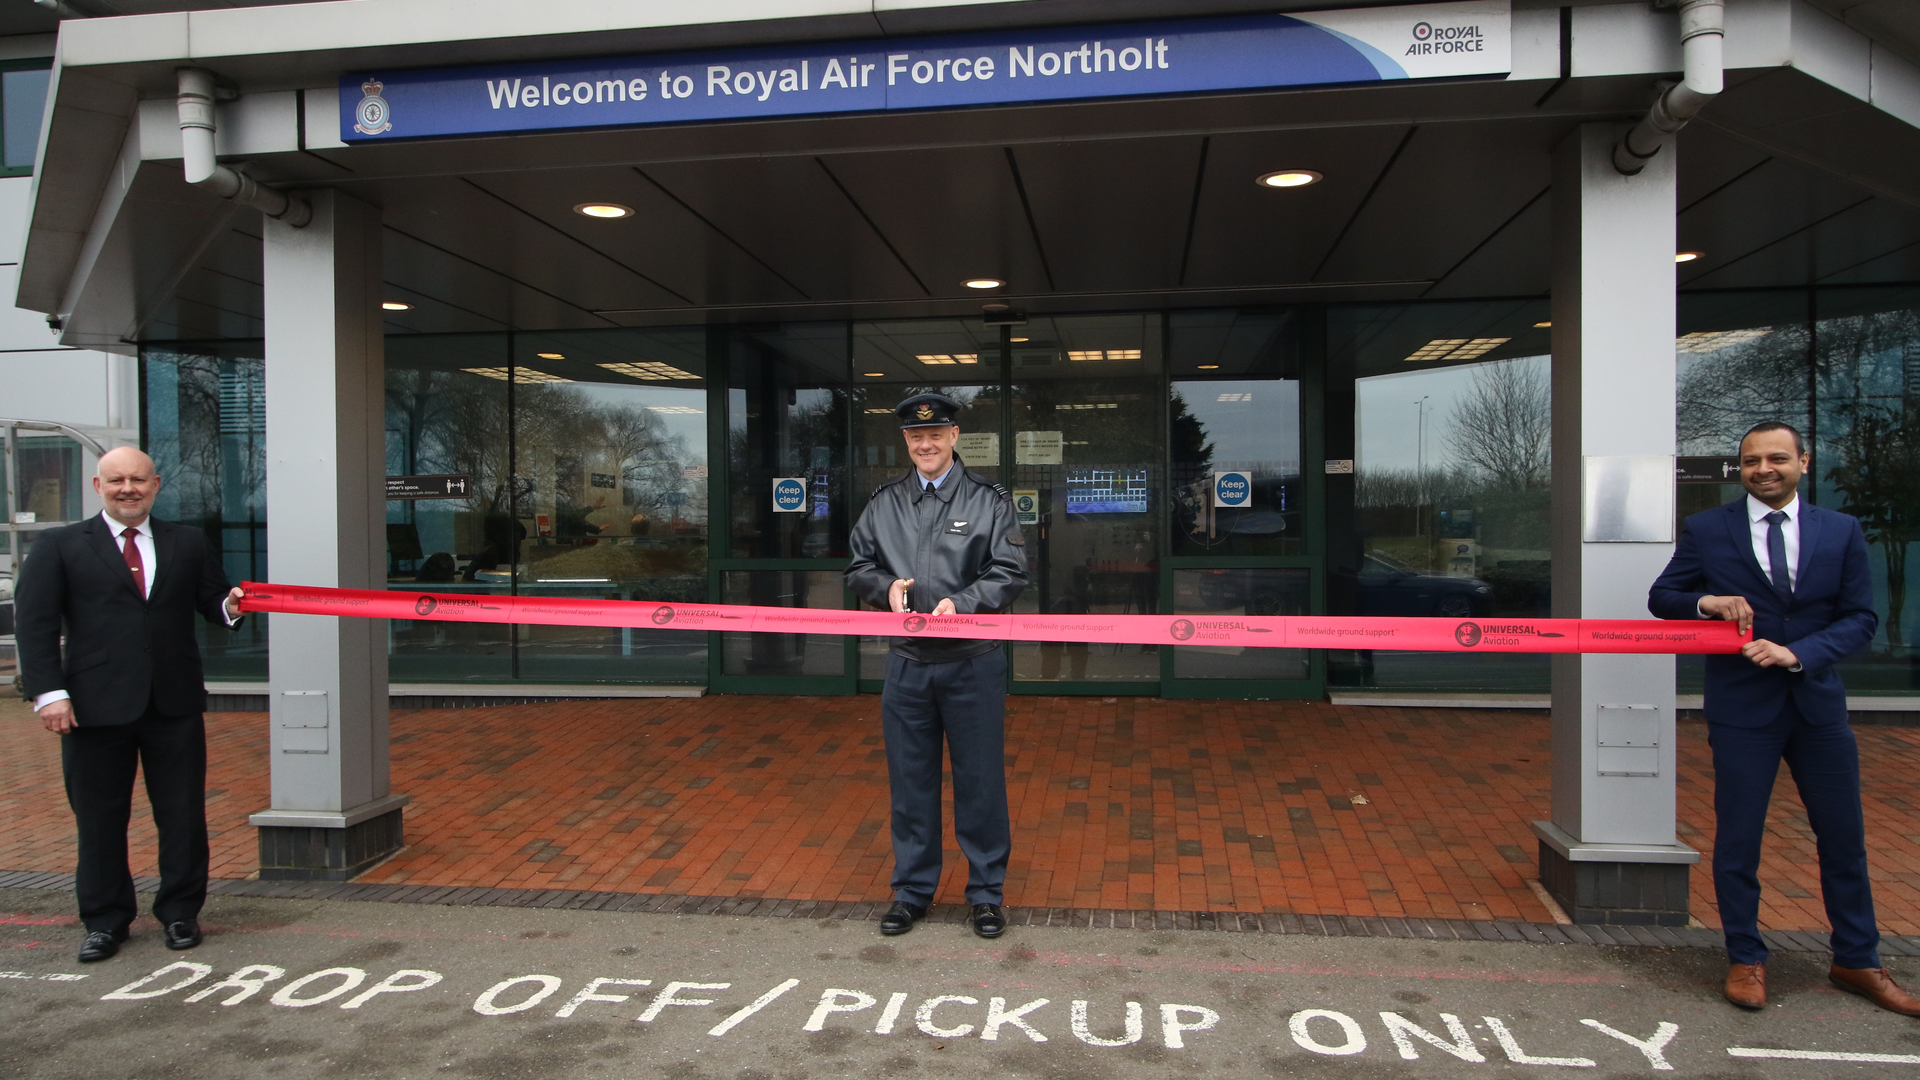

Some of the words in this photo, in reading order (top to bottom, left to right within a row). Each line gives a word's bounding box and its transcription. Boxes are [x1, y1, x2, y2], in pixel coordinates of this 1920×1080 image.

[1434, 25, 1484, 40] ROYAL
[1405, 43, 1432, 56] AIR
[1434, 39, 1484, 54] FORCE
[486, 76, 648, 110] Welcome
[658, 70, 695, 99] to
[706, 60, 808, 102] Royal
[819, 57, 876, 90] Air
[887, 54, 996, 87] Force
[1008, 38, 1170, 79] Northolt
[1221, 480, 1245, 489] Keep
[778, 486, 800, 495] Keep
[1221, 490, 1244, 498] clear
[293, 594, 323, 603] Worldwide
[323, 597, 345, 606] ground
[438, 598, 480, 608] UNIVERSAL
[434, 607, 465, 615] Aviation
[521, 606, 555, 614] Worldwide
[554, 608, 578, 616] ground
[676, 609, 720, 618] UNIVERSAL
[672, 616, 704, 625] Aviation
[764, 615, 799, 623] Worldwide
[799, 617, 824, 625] ground
[928, 617, 975, 626] UNIVERSAL
[926, 624, 960, 633] Aviation
[1022, 622, 1060, 631] Worldwide
[1060, 623, 1086, 632] ground
[1196, 621, 1246, 631] UNIVERSAL
[1482, 624, 1536, 635] UNIVERSAL
[1195, 631, 1231, 641] Aviation
[1297, 627, 1337, 636] Worldwide
[1337, 628, 1365, 638] ground
[1592, 631, 1634, 641] Worldwide
[1634, 632, 1664, 643] ground
[1482, 636, 1520, 646] Aviation
[99, 960, 445, 1010] DROP
[1288, 1007, 1682, 1072] ONLY
